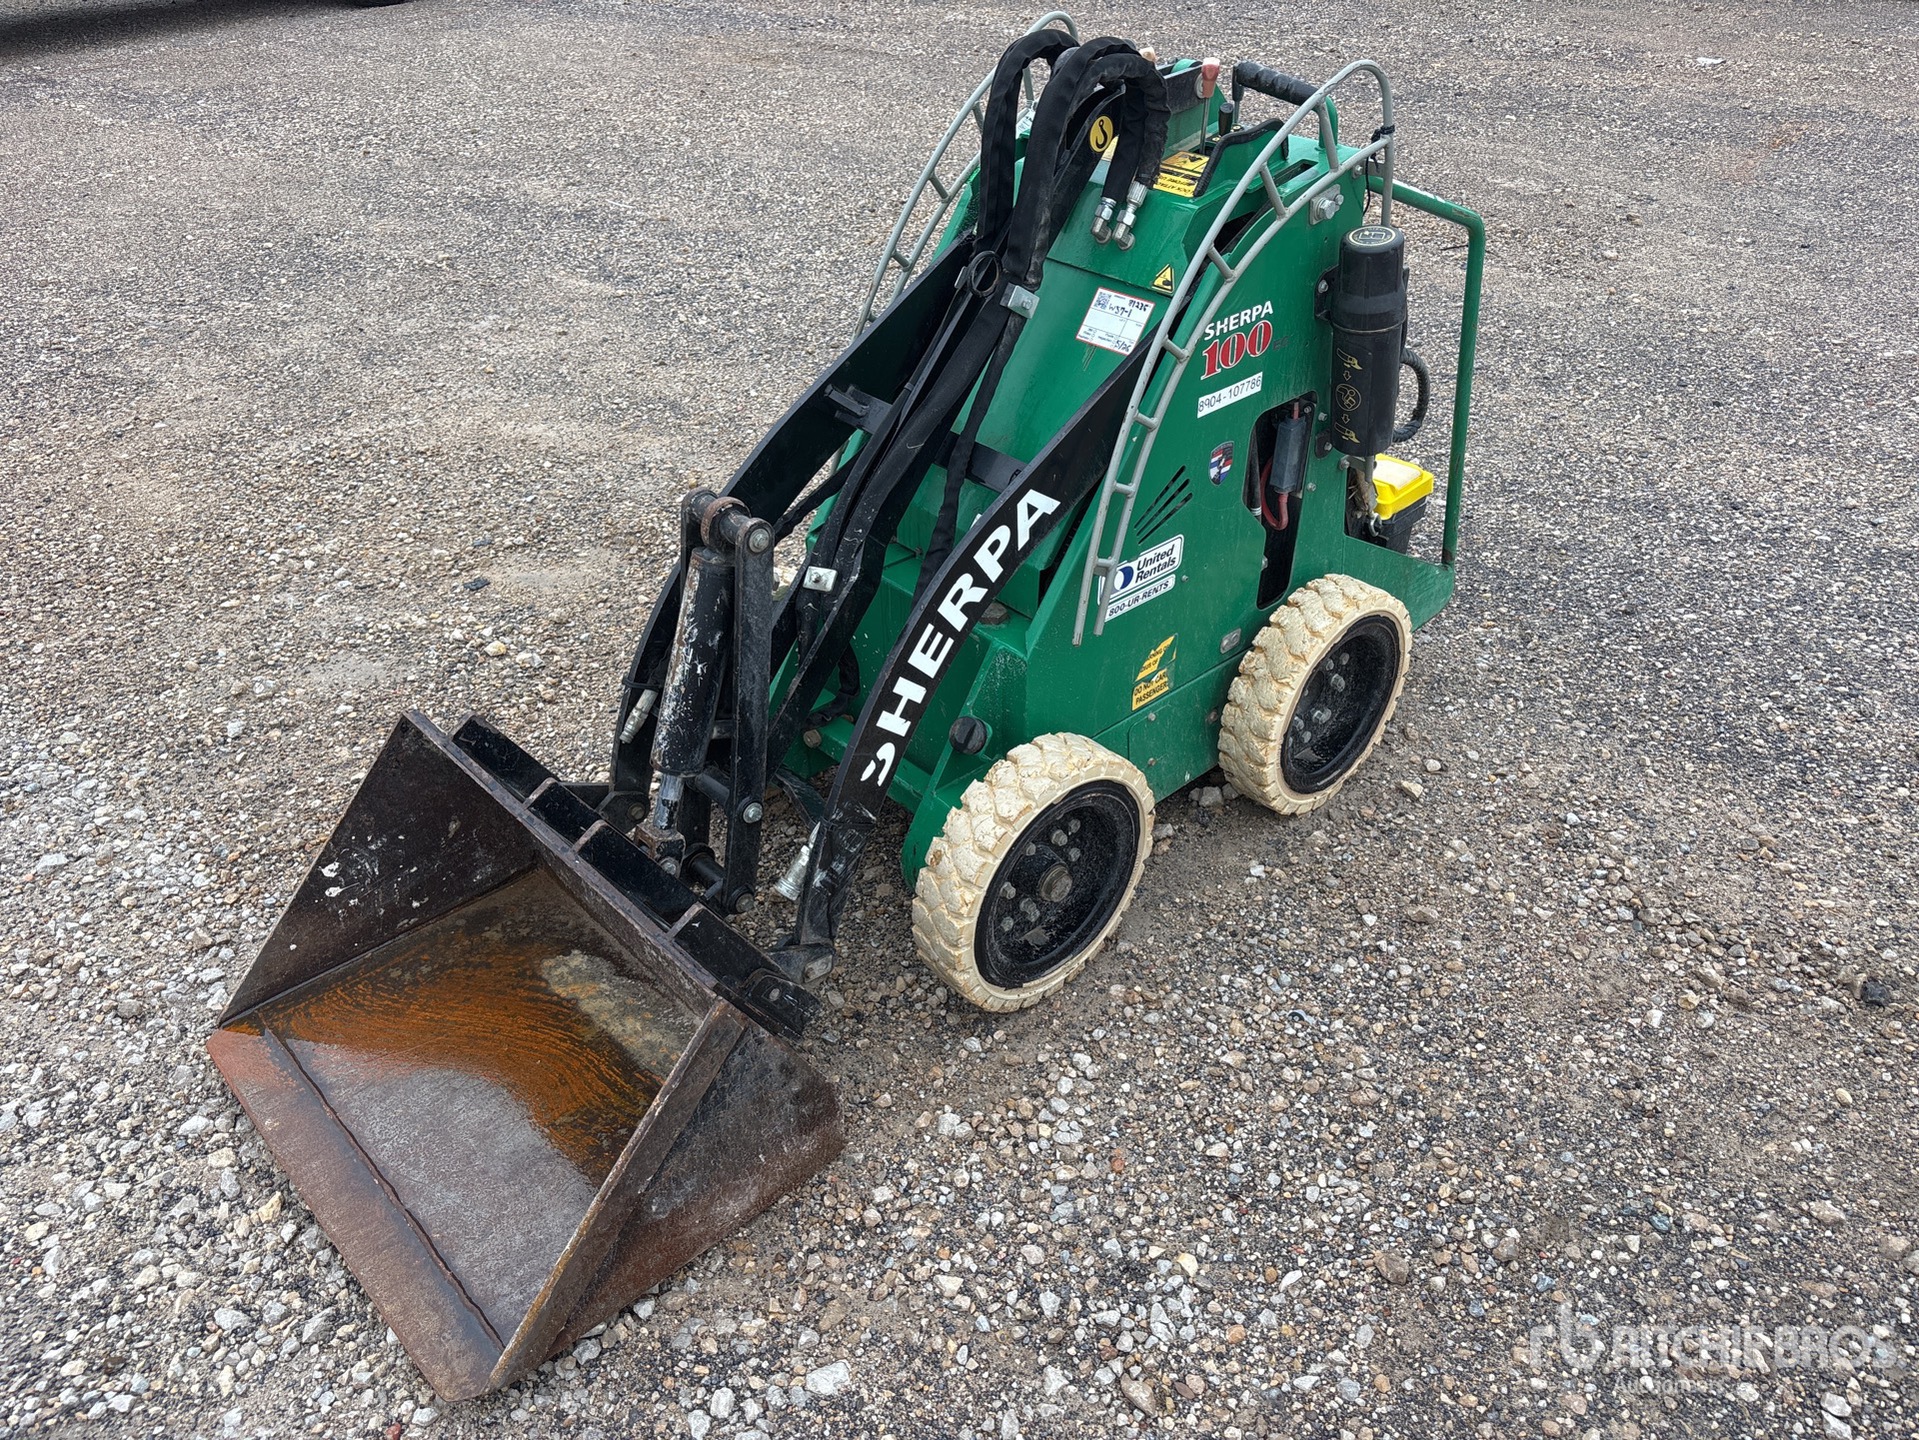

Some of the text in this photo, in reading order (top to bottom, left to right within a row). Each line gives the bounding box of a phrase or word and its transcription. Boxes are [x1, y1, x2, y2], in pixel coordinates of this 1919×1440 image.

[1204, 301, 1273, 340] SHERPA
[1201, 320, 1273, 381] 100
[1135, 557, 1176, 584] Rentals
[1136, 544, 1175, 571] United
[1108, 580, 1169, 617] 800-UR-RENTS
